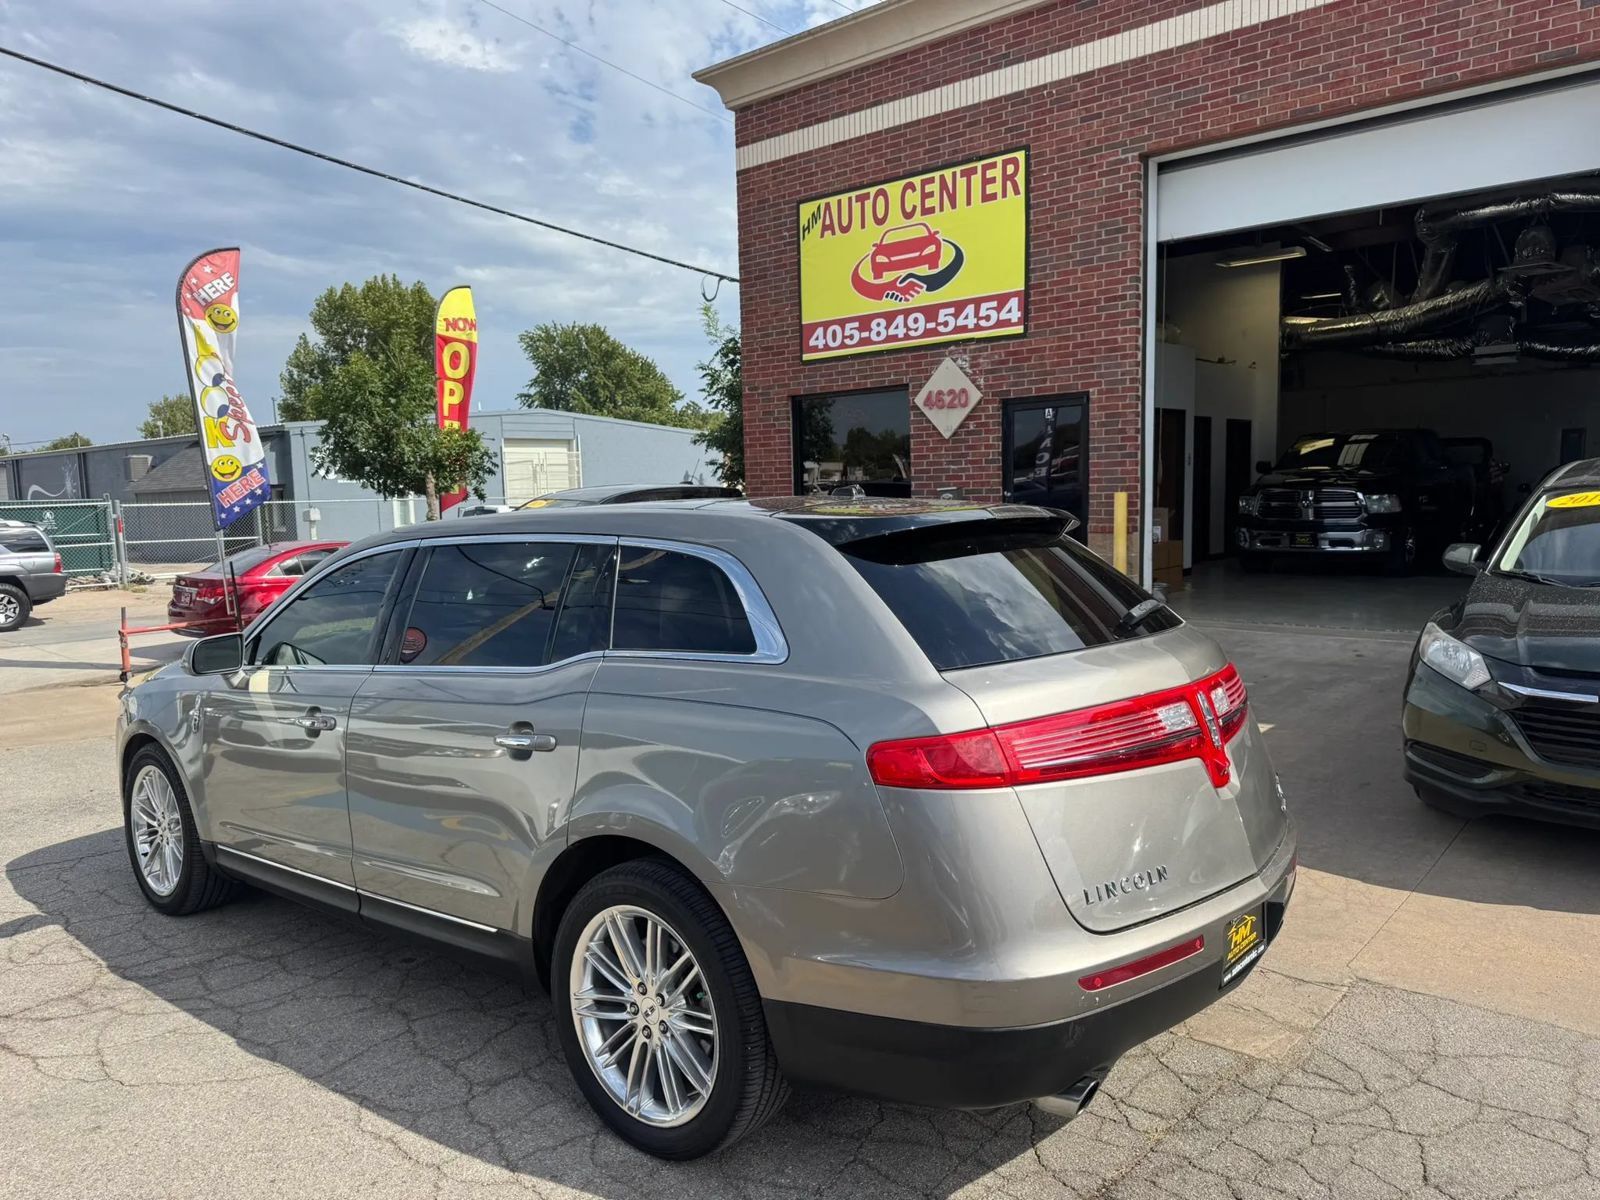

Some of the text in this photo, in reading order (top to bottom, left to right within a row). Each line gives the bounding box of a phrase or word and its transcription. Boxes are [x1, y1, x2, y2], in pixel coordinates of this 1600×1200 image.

[801, 156, 1021, 240] HM AUTO CENTER
[192, 271, 235, 306] HERE
[808, 296, 1021, 349] 405-849-5454
[922, 388, 970, 410] 4620
[216, 468, 266, 508] HERE
[1082, 865, 1168, 905] LINCOLN
